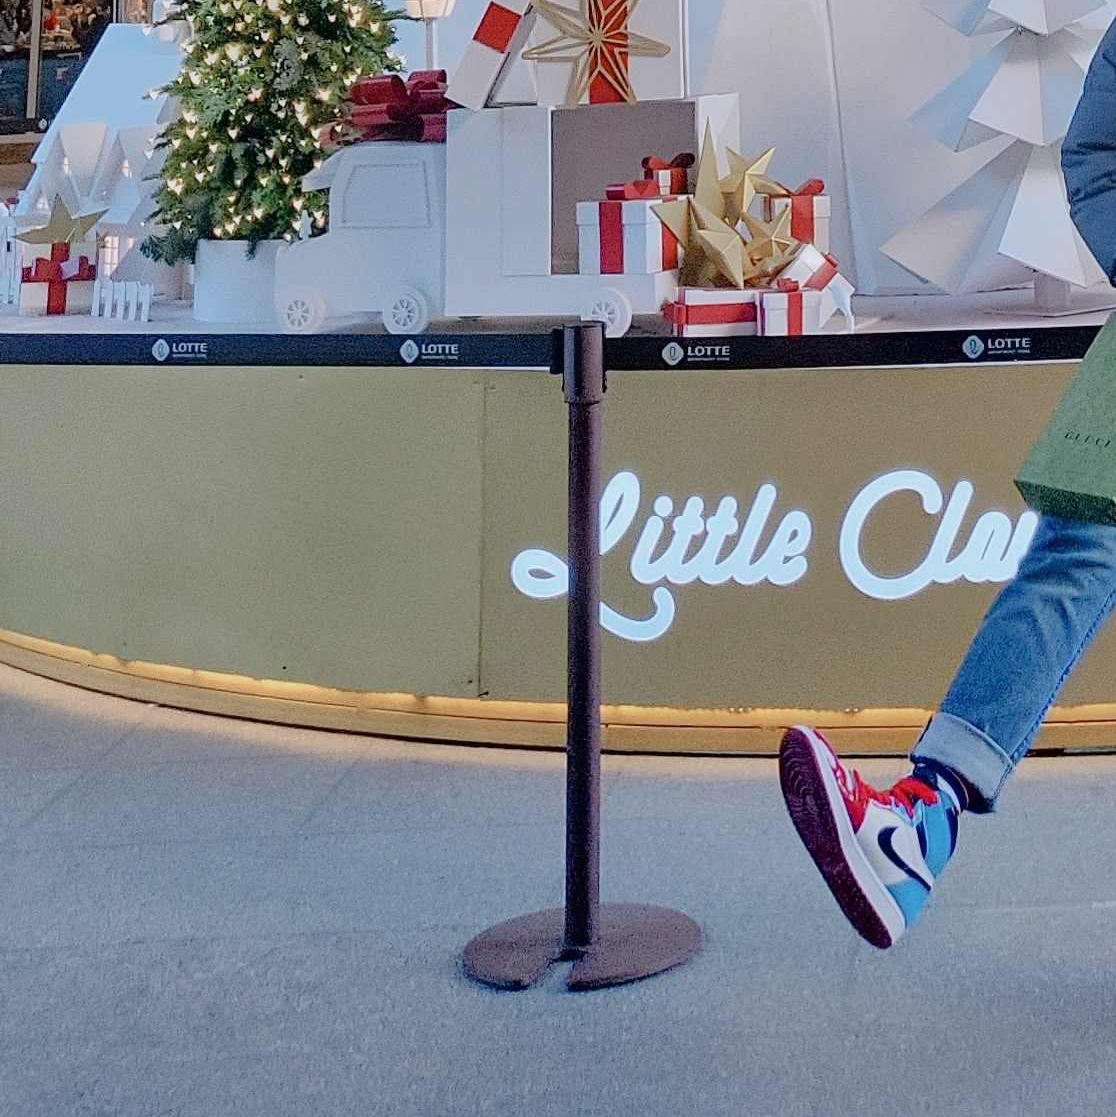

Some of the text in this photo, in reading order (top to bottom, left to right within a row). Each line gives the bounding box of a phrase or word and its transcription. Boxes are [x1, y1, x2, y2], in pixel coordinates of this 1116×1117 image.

[172, 342, 208, 353] LOTTE
[421, 343, 459, 354] LOTTE
[987, 337, 1031, 349] LOTTE
[687, 345, 730, 356] LOTTE
[510, 470, 812, 642] Little
